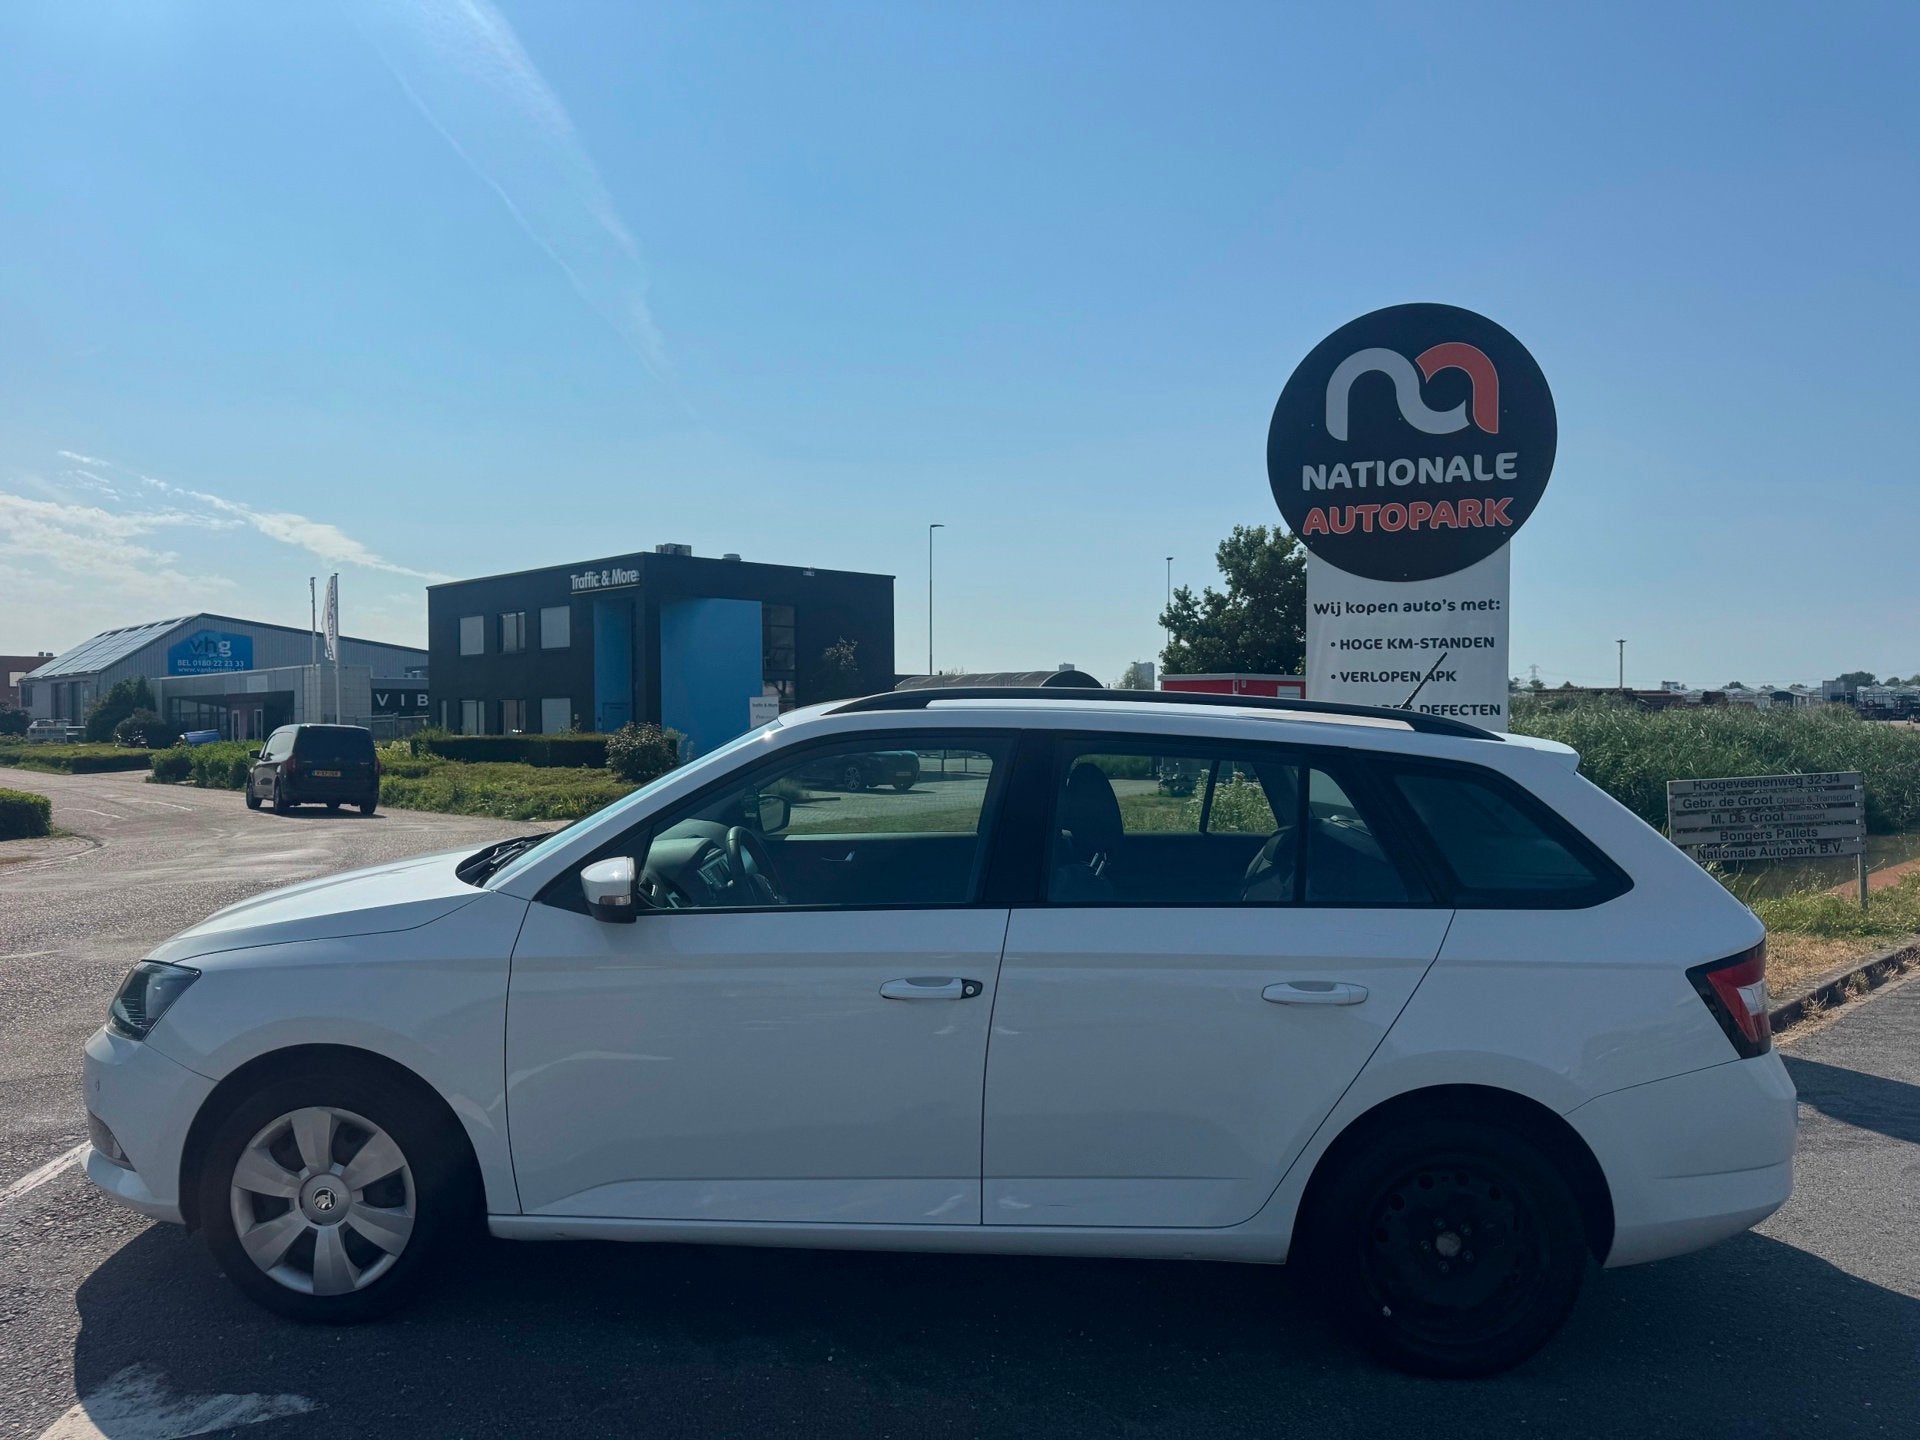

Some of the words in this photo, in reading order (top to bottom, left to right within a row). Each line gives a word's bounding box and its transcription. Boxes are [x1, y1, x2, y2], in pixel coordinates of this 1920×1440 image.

[1302, 451, 1518, 491] NATIONALE
[1302, 497, 1514, 536] AUTOPARK
[570, 571, 600, 590] Traffic
[601, 570, 609, 586] &
[611, 568, 640, 585] More
[1313, 601, 1341, 617] Wij
[1345, 600, 1398, 615] kopen
[1402, 598, 1456, 613] auto's
[1460, 598, 1500, 611] met:
[190, 636, 232, 657] vhg
[1340, 638, 1383, 650] HOGE
[1387, 636, 1495, 650] KM-STANDEN
[177, 659, 191, 667] BEL
[1340, 671, 1421, 683] VERLOPEN
[1425, 670, 1457, 682] APK
[1420, 704, 1501, 716] DEFECTEN
[1693, 777, 1803, 791] Hoogeveenenweg
[1807, 773, 1840, 785] 32-34
[1682, 798, 1715, 809] Gebr.
[1719, 797, 1734, 807] de
[1738, 795, 1773, 806] Groot
[1711, 814, 1725, 825] M.
[1729, 813, 1746, 823] De
[1749, 812, 1784, 823] Groot
[1788, 813, 1825, 822] Transport
[1720, 831, 1773, 842] Bongers
[1776, 828, 1818, 839] Pallets
[1697, 847, 1756, 860] Nationale
[1760, 844, 1816, 857] Autopark
[1820, 842, 1844, 854] B.V.
